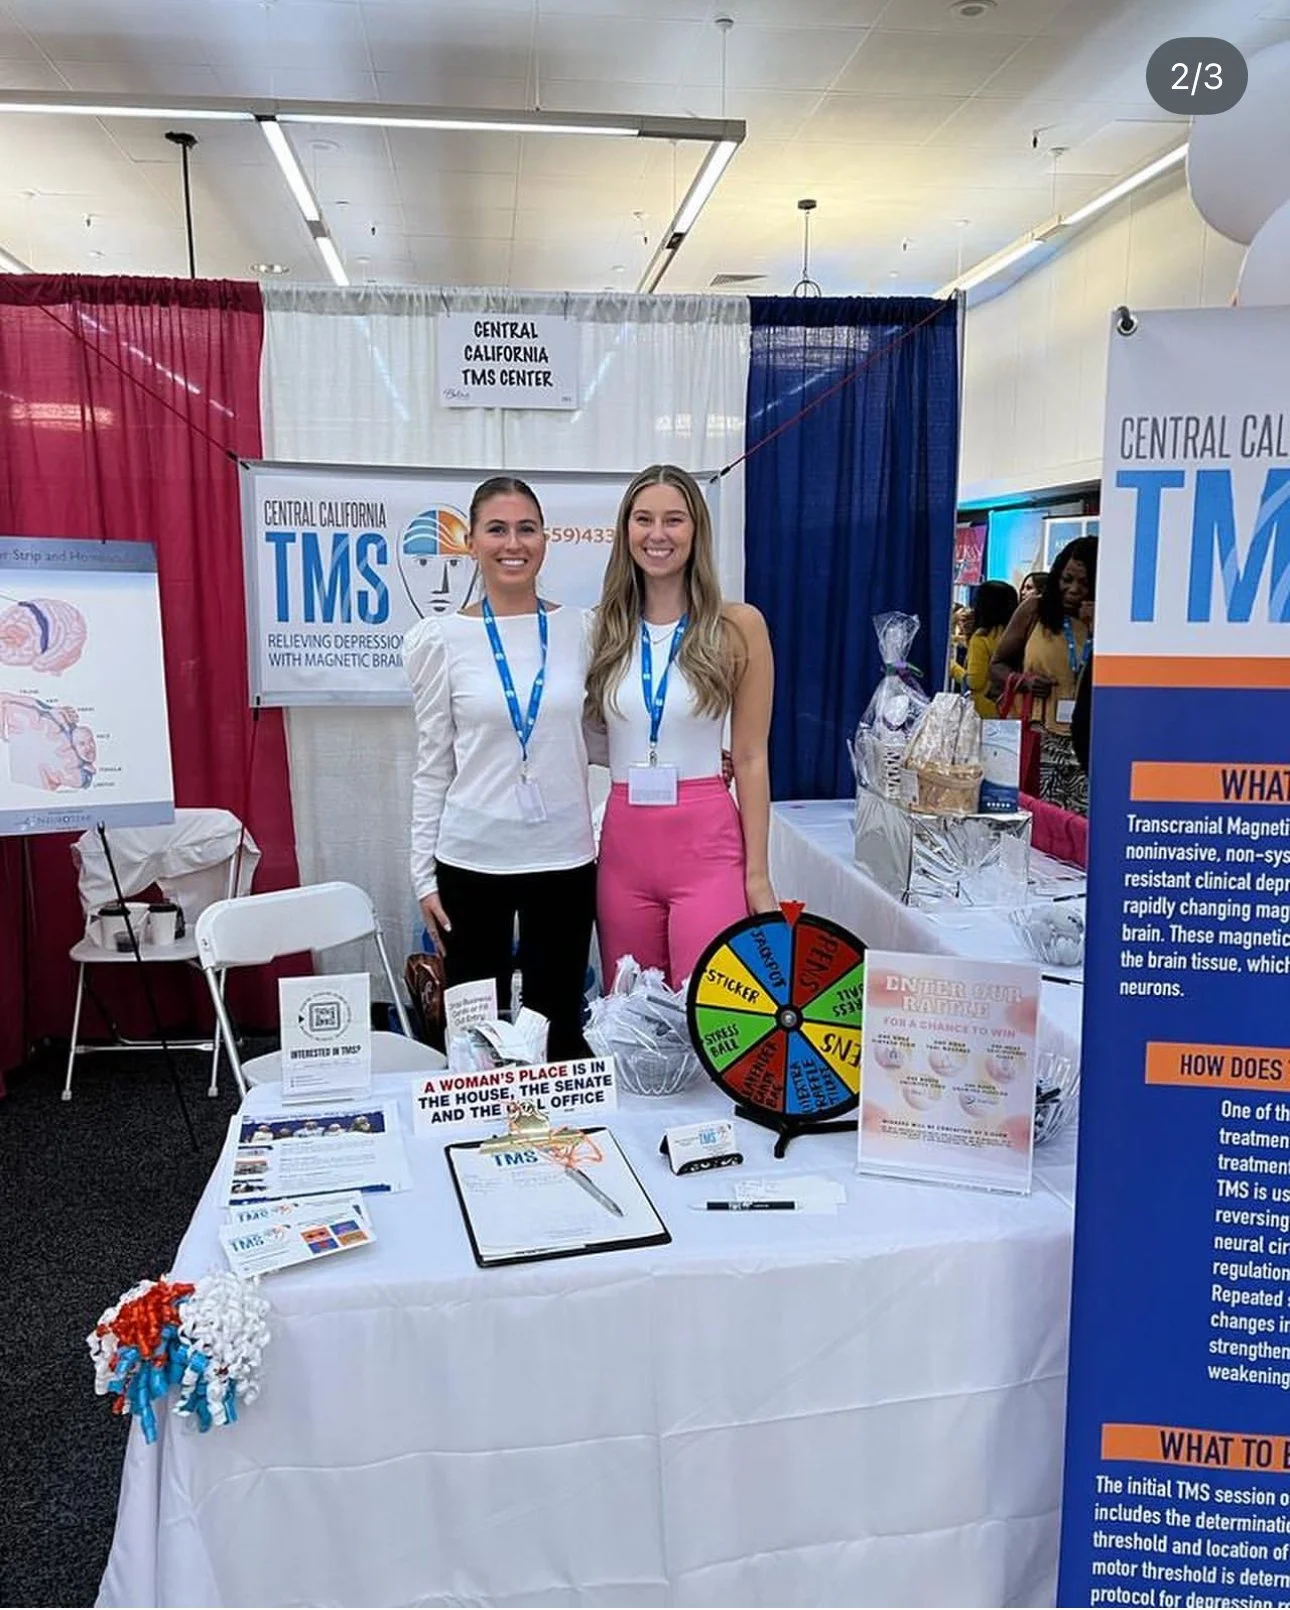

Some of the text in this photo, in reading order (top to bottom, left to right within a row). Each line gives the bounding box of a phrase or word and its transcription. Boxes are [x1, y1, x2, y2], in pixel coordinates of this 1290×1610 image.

[474, 321, 538, 339] CENTRAL
[464, 345, 549, 363] CALIFORNIA
[462, 369, 554, 387] TMS CENTER
[1120, 415, 1231, 460] CENTRAL
[264, 500, 387, 528] CENTRAL CALIFORNIA
[12, 548, 41, 564] Strip
[45, 548, 66, 561] and
[265, 531, 390, 625] TMS
[268, 634, 332, 649] RELIEVING
[268, 653, 404, 668] WITH MAGNETIC BRAI
[1127, 814, 1223, 835] Transcranial
[1126, 842, 1290, 868] noninvasive, non-sys
[1124, 870, 1290, 896] resistant clinical depr
[1123, 897, 1290, 923] rapidly changing mag
[1122, 923, 1290, 950] brain. These magnetic
[751, 930, 787, 988] JACKPOT
[800, 933, 840, 991] PENS
[1120, 950, 1290, 974] the brain tissue, which
[707, 969, 760, 1004] STICKER
[886, 975, 966, 998] ENTER
[1120, 982, 1185, 997] neurons.
[704, 1023, 739, 1046] STRESS
[883, 1015, 1016, 1039] FOR A CHANCE TO WIN
[290, 1044, 362, 1060] INTERESTED IN TMS?
[710, 1039, 740, 1058] BALL
[424, 1060, 606, 1094] A WOMAN'S PLACE IS IN
[1180, 1054, 1283, 1081] HOW DOES
[418, 1074, 613, 1110] THE HOUSE, THE SENATE
[431, 1108, 465, 1125] AND
[469, 1103, 501, 1119] THE
[550, 1091, 606, 1108] OFFICE
[1221, 1100, 1251, 1119] One
[1256, 1102, 1273, 1120] of
[493, 1151, 538, 1167] TMS
[1217, 1180, 1249, 1199] TMS
[1253, 1182, 1268, 1201] is
[1215, 1208, 1290, 1232] reversing
[1214, 1235, 1264, 1253] neural
[1213, 1261, 1290, 1282] regulation
[1211, 1284, 1283, 1307] Repeated
[1210, 1311, 1276, 1335] changes
[1209, 1339, 1290, 1361] strengthen
[1208, 1364, 1290, 1389] weakening
[1160, 1430, 1234, 1465] WHAT
[1242, 1437, 1272, 1468] TO
[1096, 1475, 1122, 1494] The
[1127, 1476, 1171, 1498] initial
[1176, 1480, 1210, 1501] TMS
[1215, 1486, 1275, 1506] session
[1094, 1503, 1161, 1525] includes
[1166, 1508, 1190, 1528] the
[1093, 1530, 1289, 1561] threshold and location of
[1092, 1559, 1138, 1577] motor
[1142, 1561, 1217, 1584] threshold
[1222, 1566, 1235, 1584] is
[1090, 1586, 1155, 1607] protocol
[1159, 1589, 1182, 1608] for
